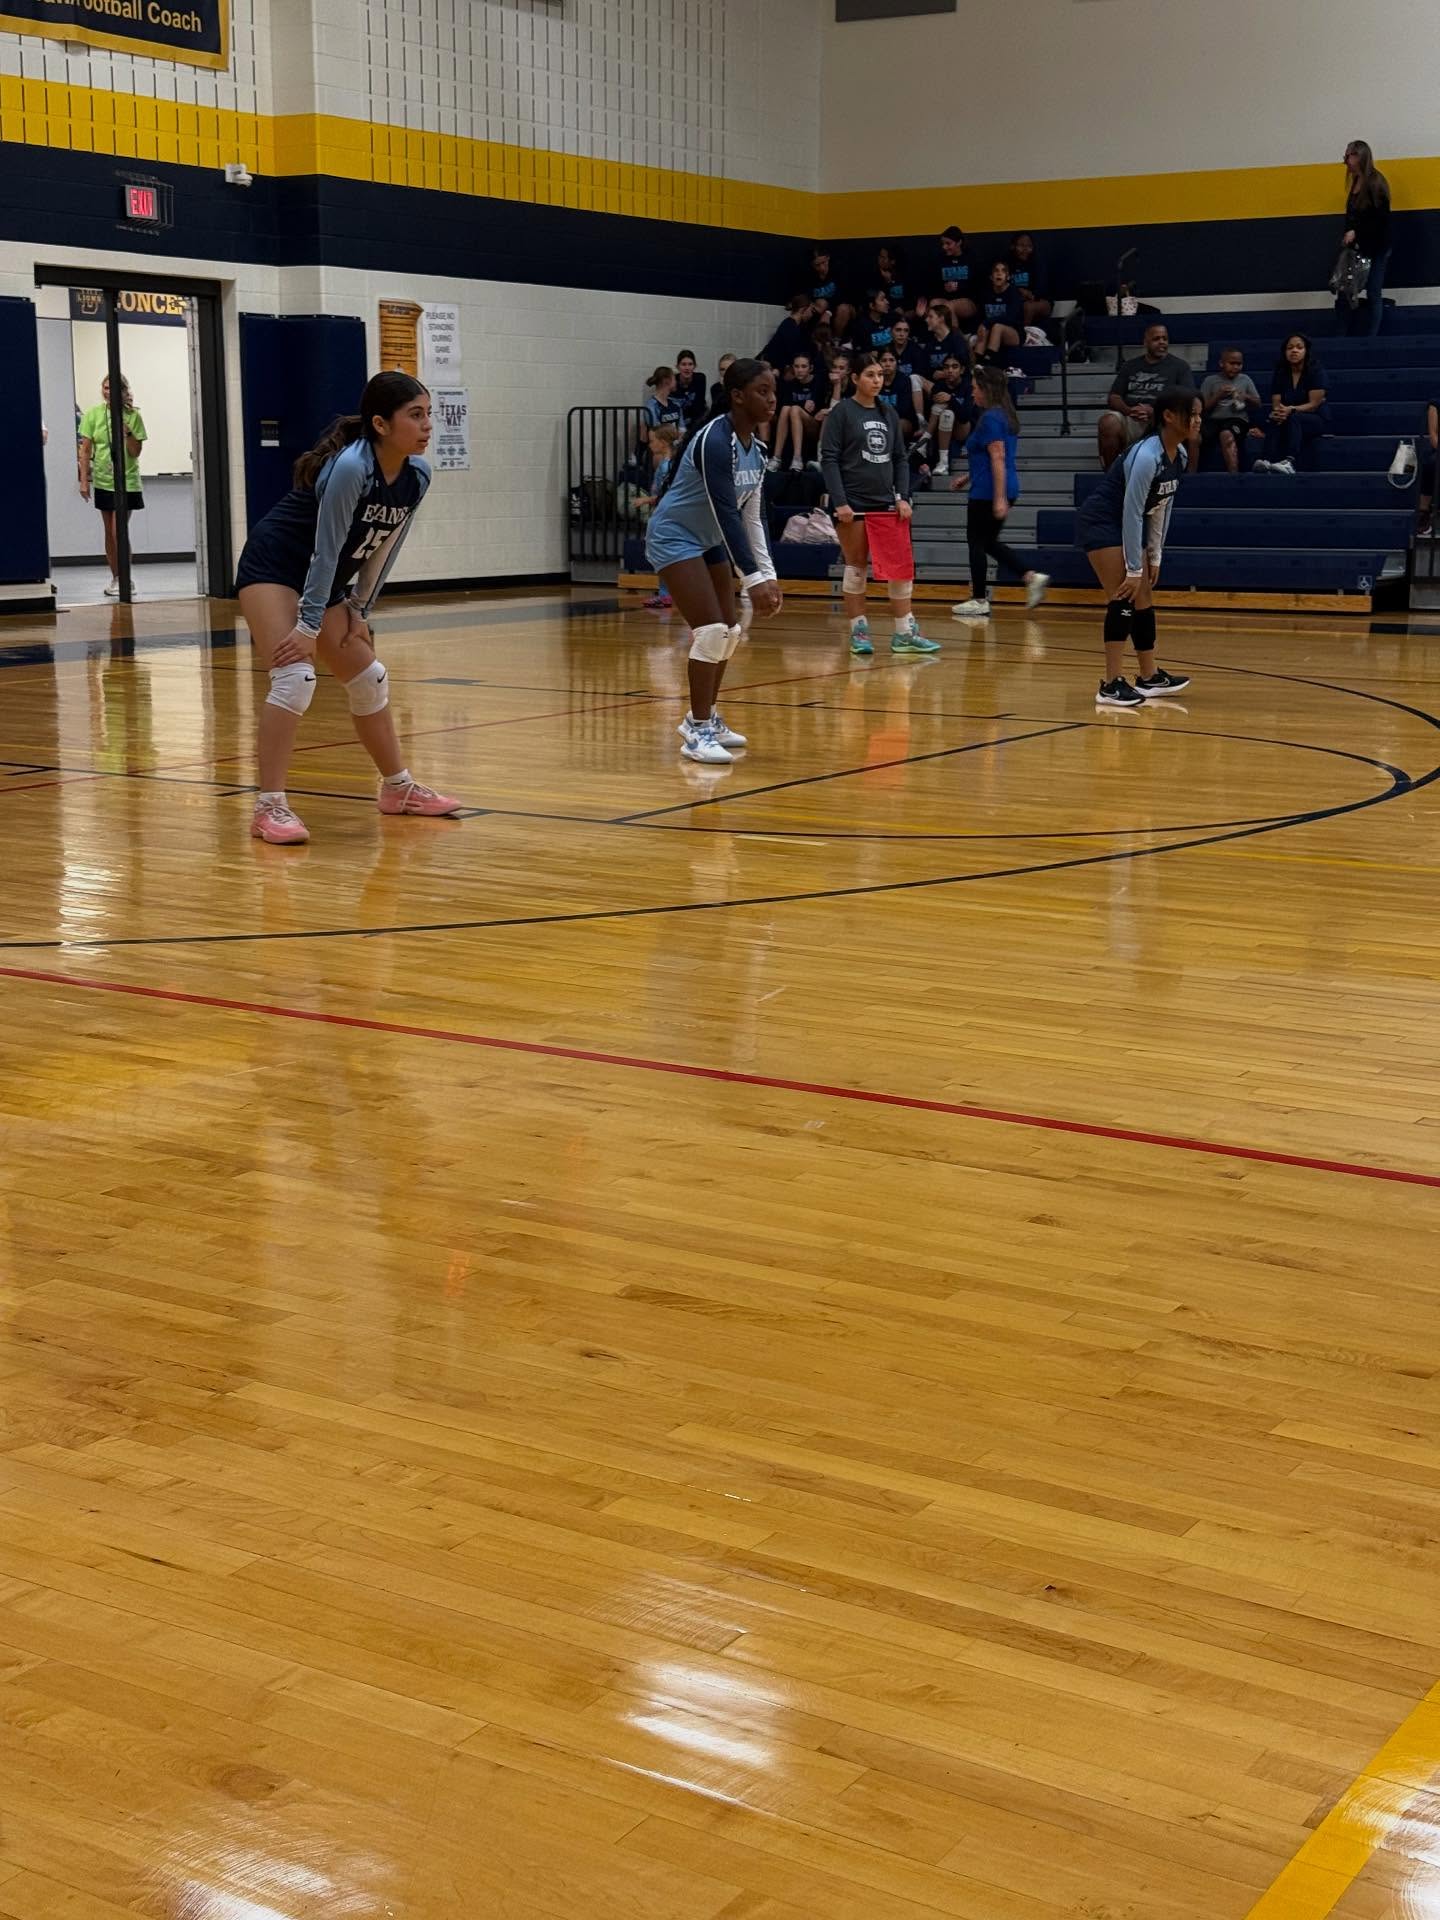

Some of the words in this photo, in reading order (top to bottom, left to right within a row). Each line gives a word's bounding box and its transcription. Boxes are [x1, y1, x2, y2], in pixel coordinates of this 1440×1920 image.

[76, 0, 143, 20] ootball
[147, 3, 202, 33] Coach
[440, 404, 467, 416] TEXAS
[445, 415, 462, 427] WAY
